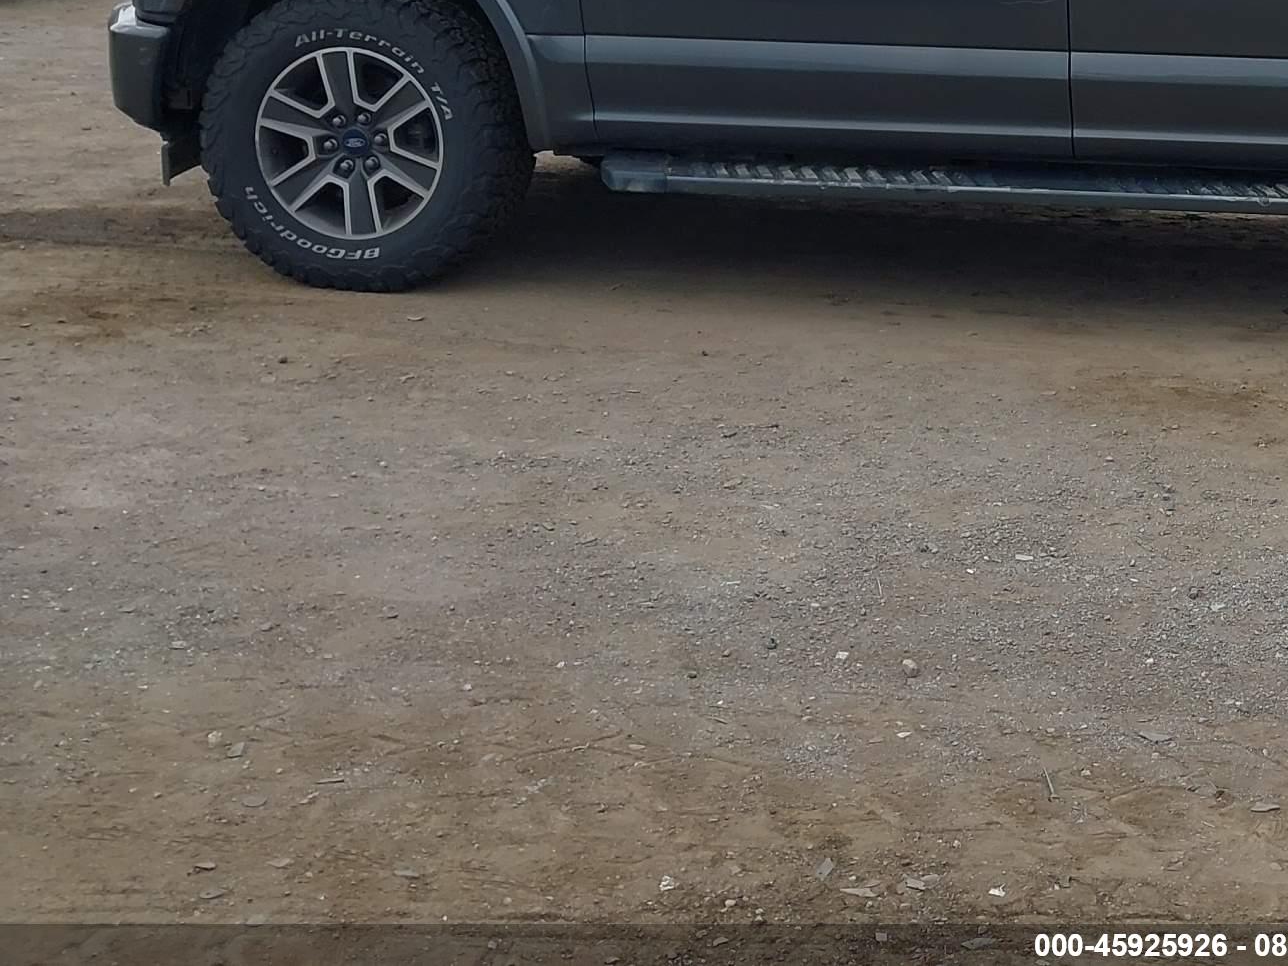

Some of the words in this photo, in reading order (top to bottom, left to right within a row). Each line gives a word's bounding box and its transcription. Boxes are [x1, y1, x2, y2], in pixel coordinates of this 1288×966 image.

[295, 28, 424, 74] All-Terrain
[430, 80, 454, 122] T/A
[244, 186, 383, 260] BFGoodrich
